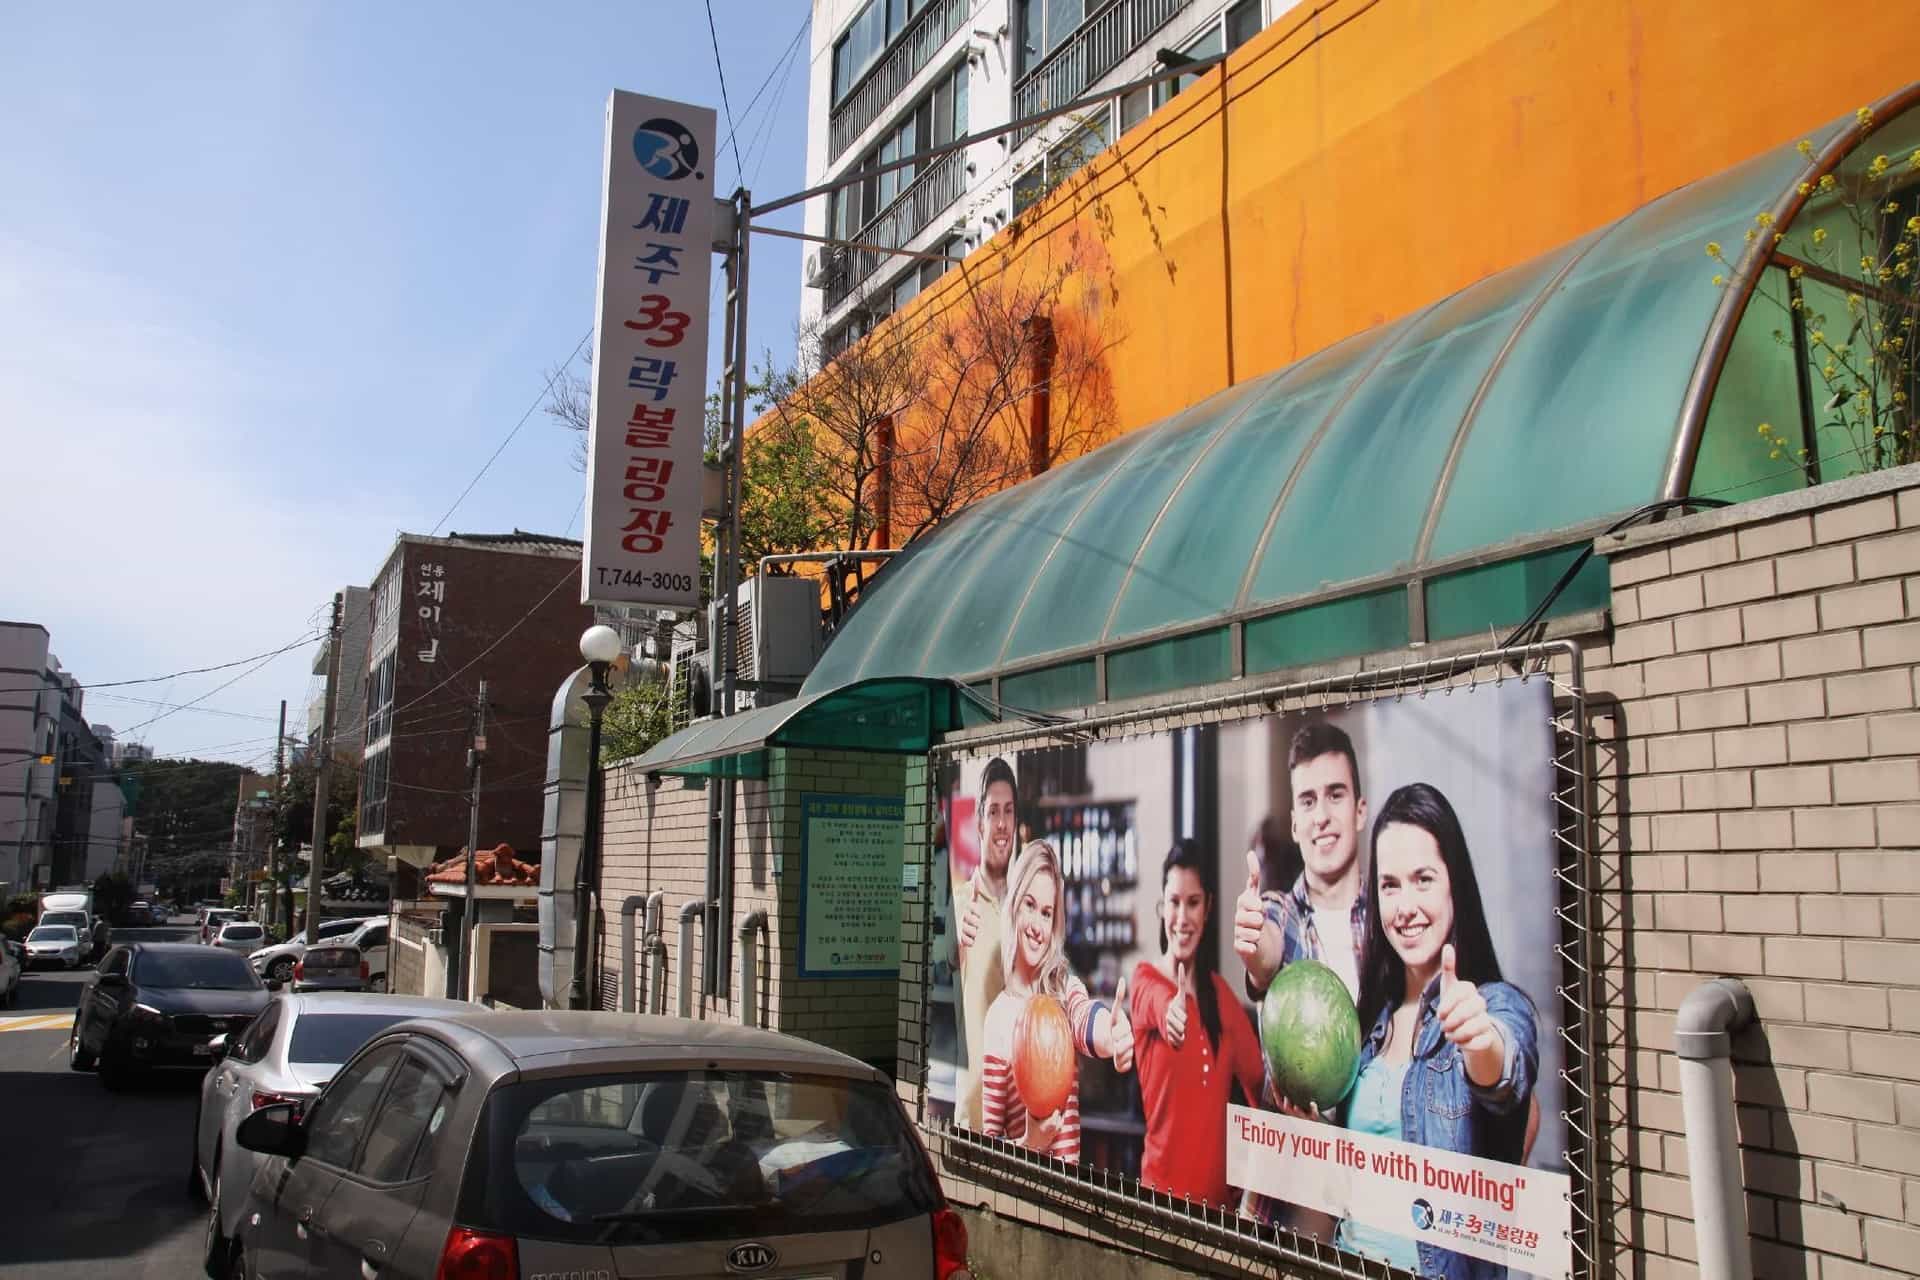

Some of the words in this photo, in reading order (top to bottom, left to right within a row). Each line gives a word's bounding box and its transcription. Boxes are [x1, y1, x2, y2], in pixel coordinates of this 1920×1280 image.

[597, 567, 692, 592] T.744-3003
[1234, 1114, 1287, 1154] "Enjoy
[1291, 1133, 1331, 1161] your
[1336, 1138, 1366, 1170] life
[1371, 1151, 1418, 1183] with
[1423, 1159, 1526, 1212] bowling"
[736, 1248, 769, 1265] KIA
